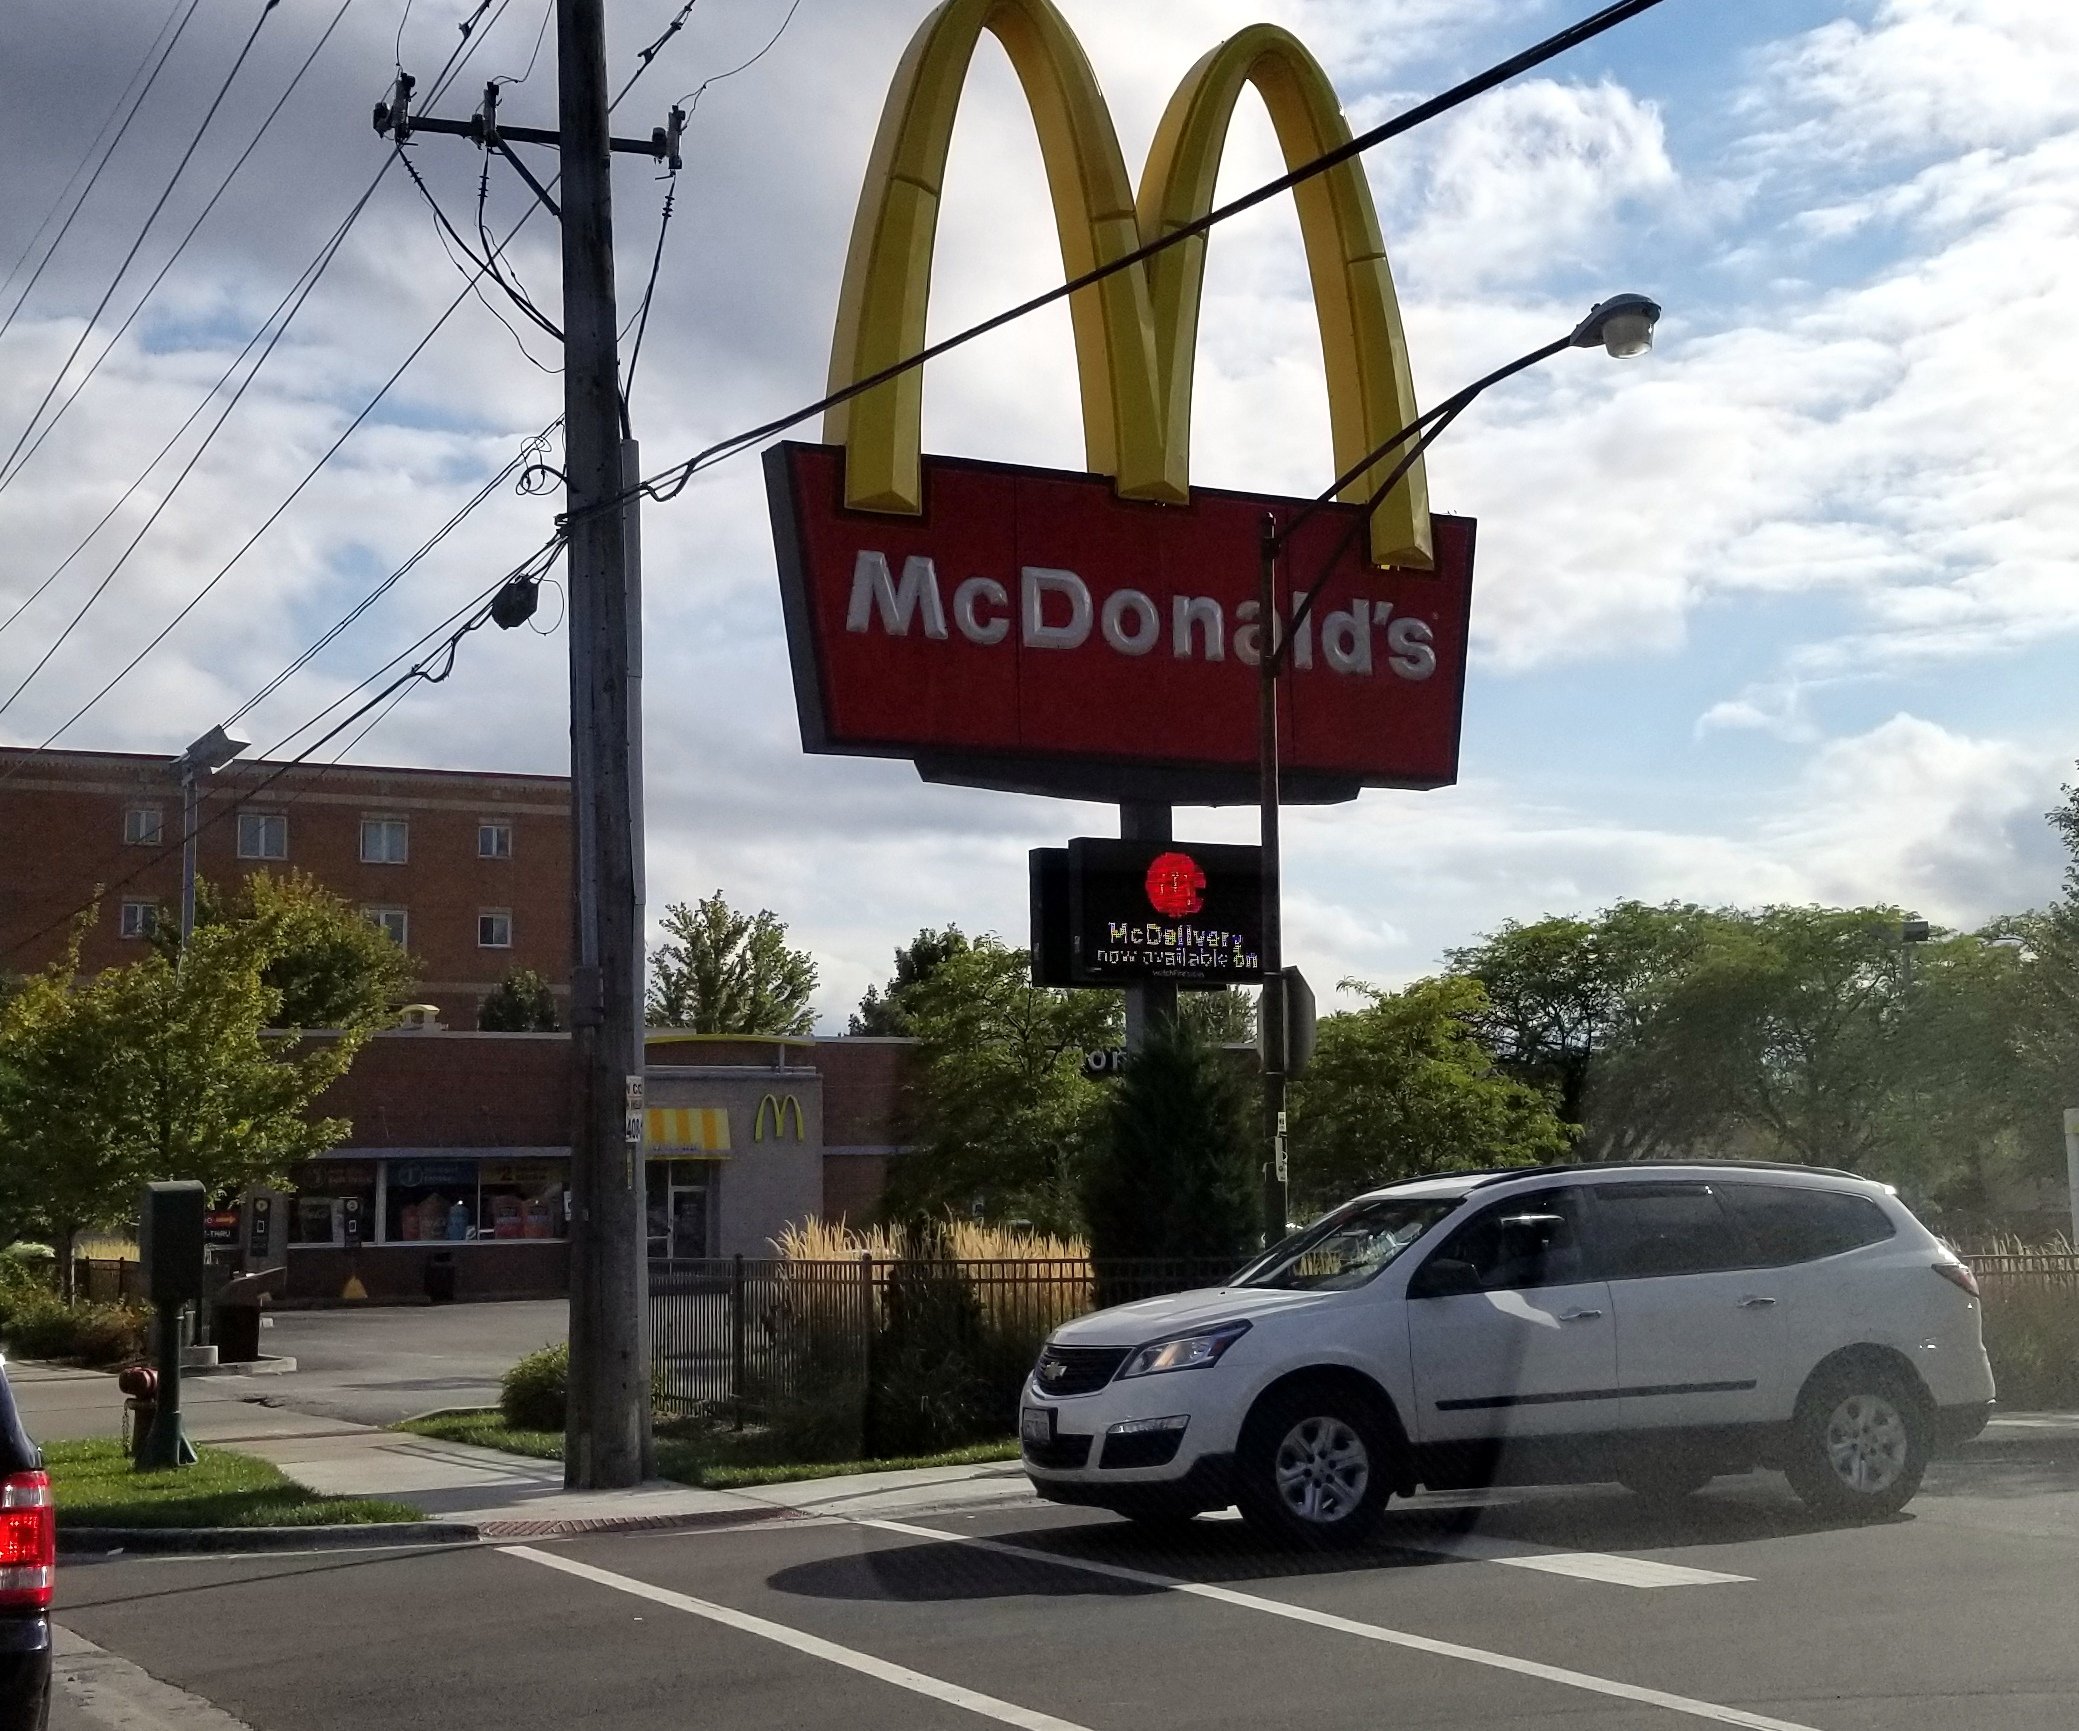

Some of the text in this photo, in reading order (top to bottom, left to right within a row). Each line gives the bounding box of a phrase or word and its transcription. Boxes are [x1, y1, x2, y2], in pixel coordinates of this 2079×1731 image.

[845, 550, 1438, 682] McDonald's
[1097, 949, 1138, 964] now
[1142, 947, 1229, 967] available
